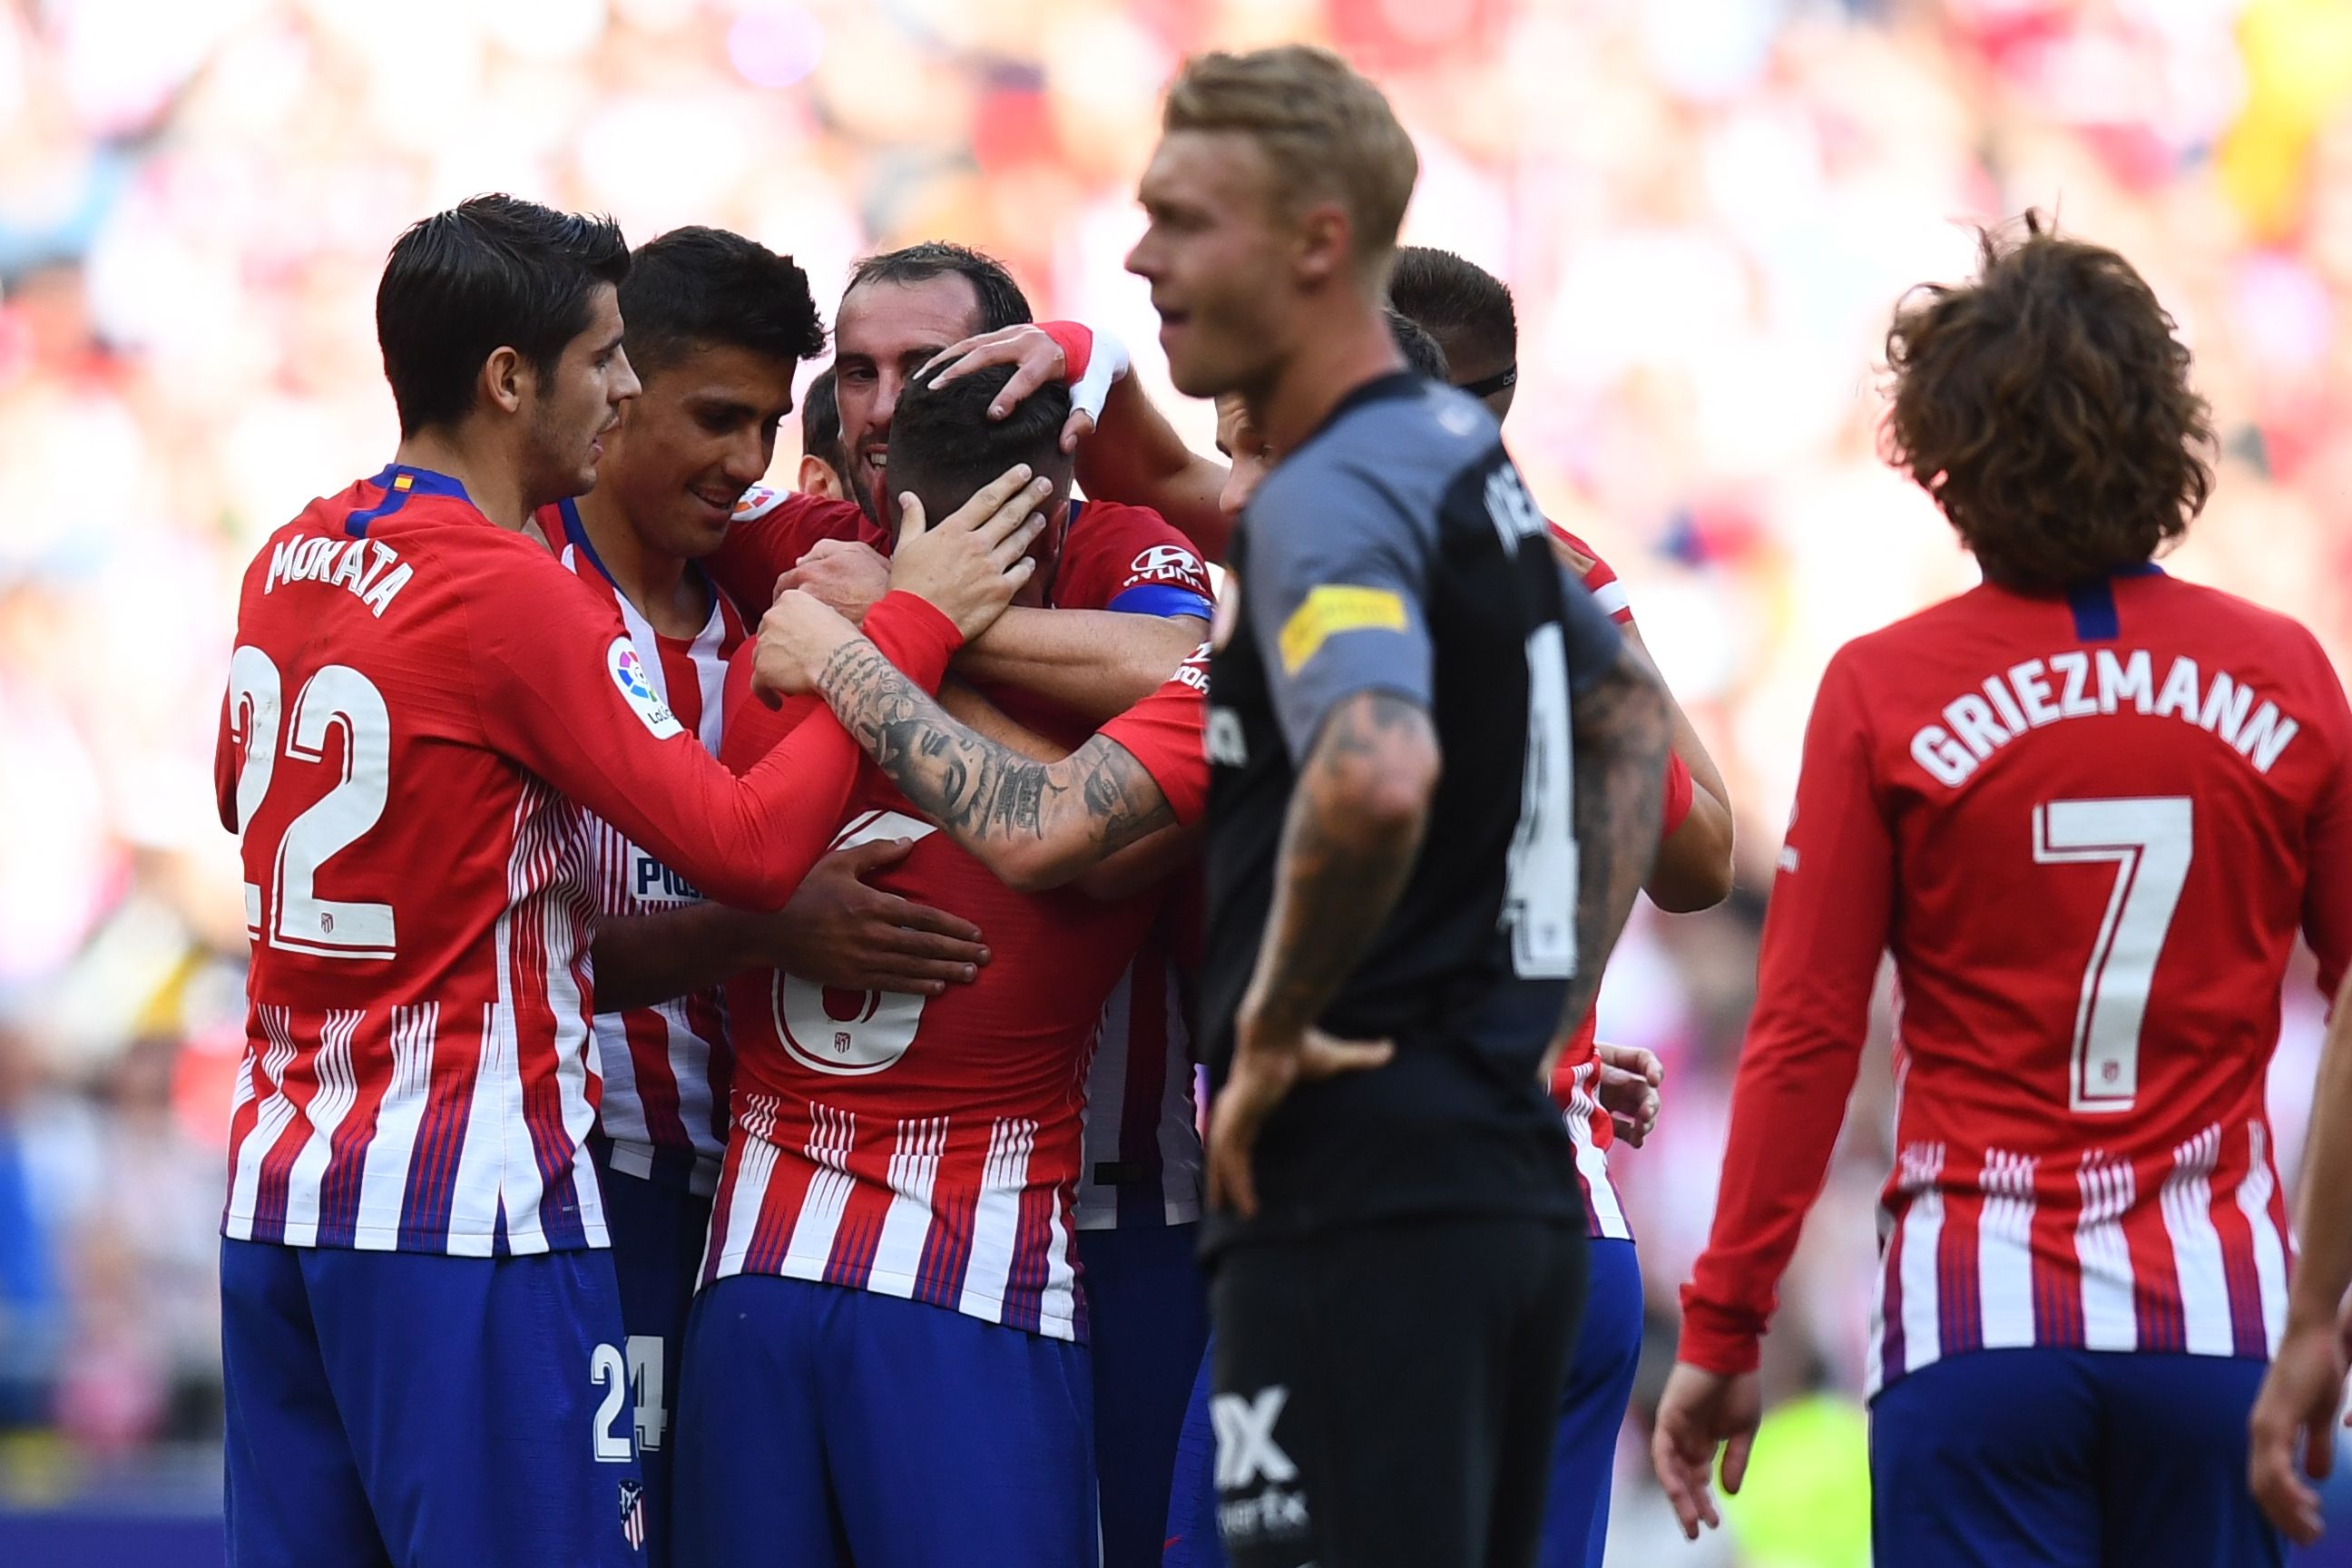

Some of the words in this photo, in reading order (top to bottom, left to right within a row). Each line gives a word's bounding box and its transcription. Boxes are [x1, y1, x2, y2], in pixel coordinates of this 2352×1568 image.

[230, 645, 397, 960] 22
[1910, 649, 2300, 788] GRIEZMANN
[2034, 797, 2192, 1112] 7
